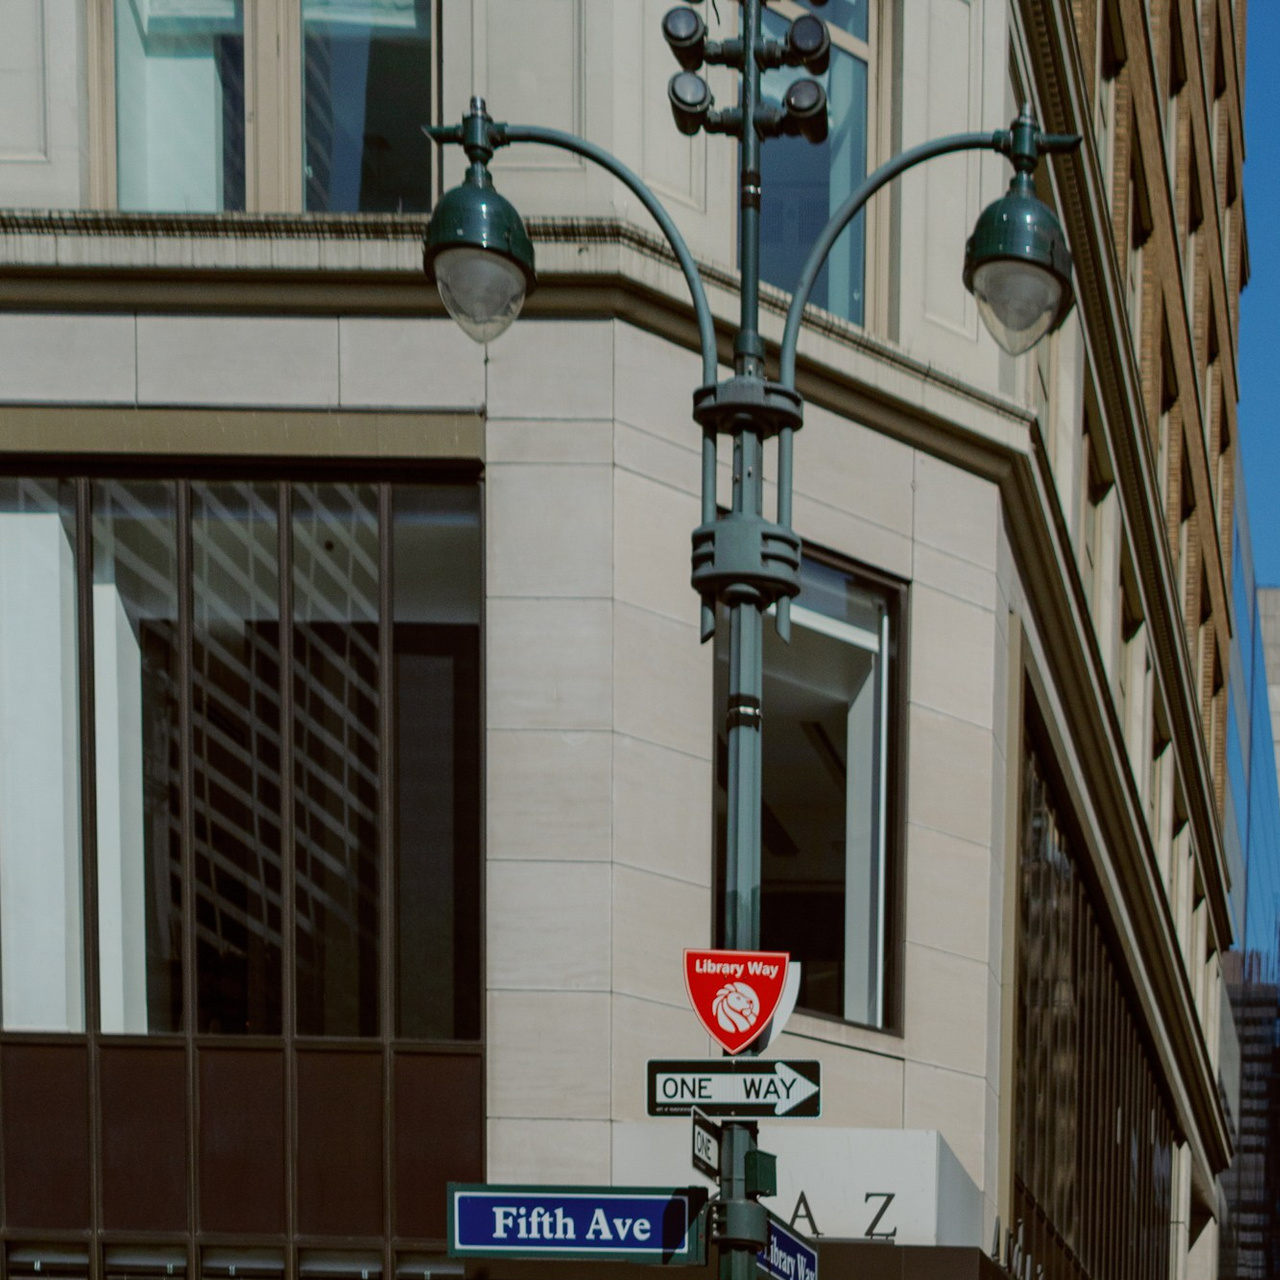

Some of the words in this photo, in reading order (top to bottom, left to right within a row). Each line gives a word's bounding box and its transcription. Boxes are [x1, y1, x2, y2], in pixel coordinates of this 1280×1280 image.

[695, 958, 745, 979] Library
[747, 961, 779, 979] Way
[662, 1077, 713, 1099] ONE
[743, 1077, 797, 1100] WAY
[696, 1129, 712, 1161] ONE
[492, 1206, 576, 1240] Fifth
[585, 1207, 652, 1242] Ave
